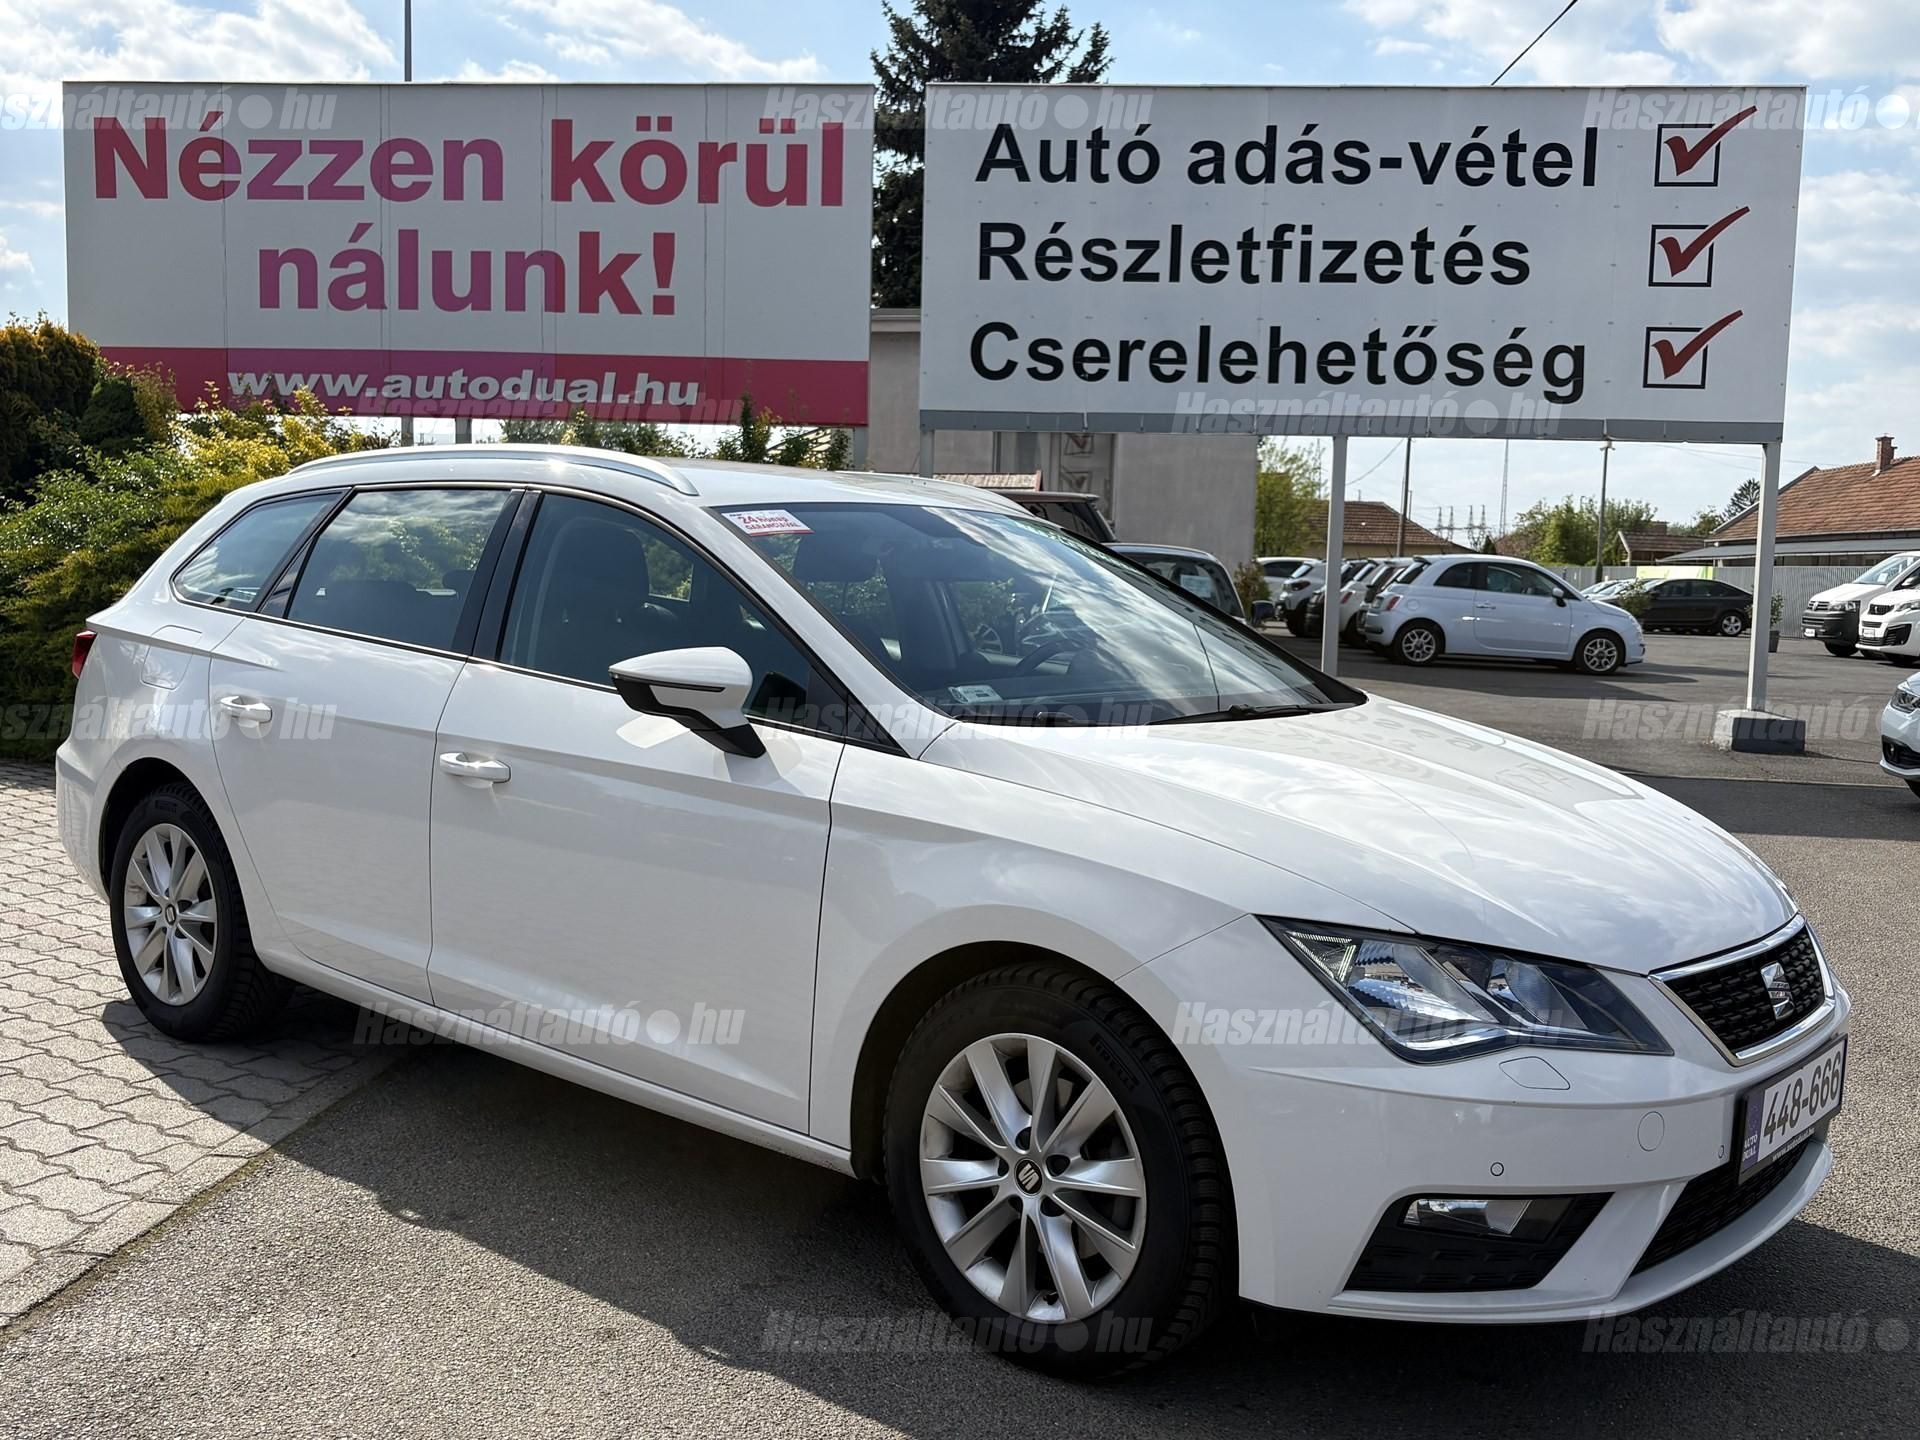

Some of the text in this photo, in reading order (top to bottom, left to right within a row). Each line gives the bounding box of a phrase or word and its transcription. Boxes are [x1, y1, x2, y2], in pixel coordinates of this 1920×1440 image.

[93, 110, 844, 208] Nézzen körül
[974, 124, 1599, 188] Autó adás-vétel
[258, 222, 677, 316] nálunk!
[977, 221, 1531, 285] Részletfizetés
[227, 368, 700, 407] www.autodual.hu
[969, 321, 1587, 403] Cserelehetőség
[1763, 1051, 1841, 1145] 448-666
